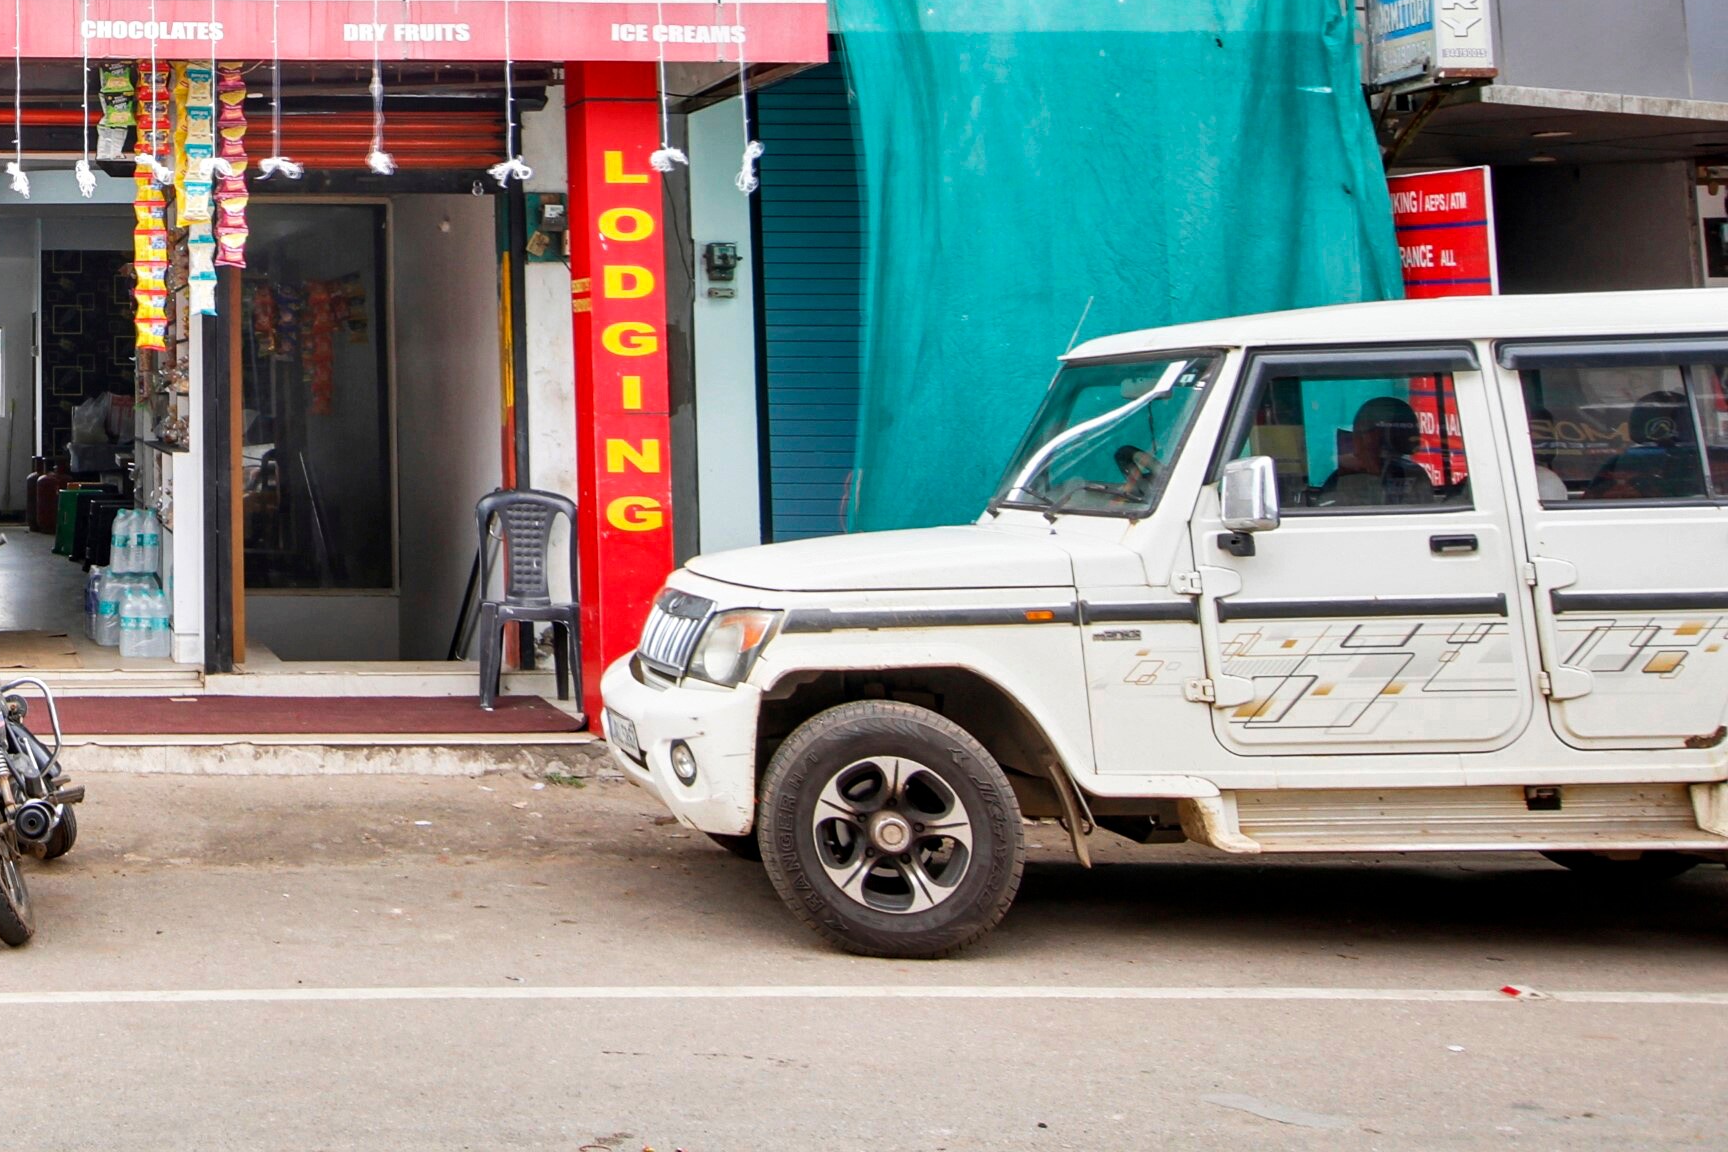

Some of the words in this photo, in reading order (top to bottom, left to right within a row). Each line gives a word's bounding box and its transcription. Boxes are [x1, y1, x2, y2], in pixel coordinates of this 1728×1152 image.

[80, 20, 225, 42] CHOCOLATES
[343, 22, 387, 43] DRY
[392, 22, 471, 43] FRUITS
[611, 22, 648, 43] ICE
[651, 23, 747, 45] CREAMS
[598, 148, 665, 532] LODGING
